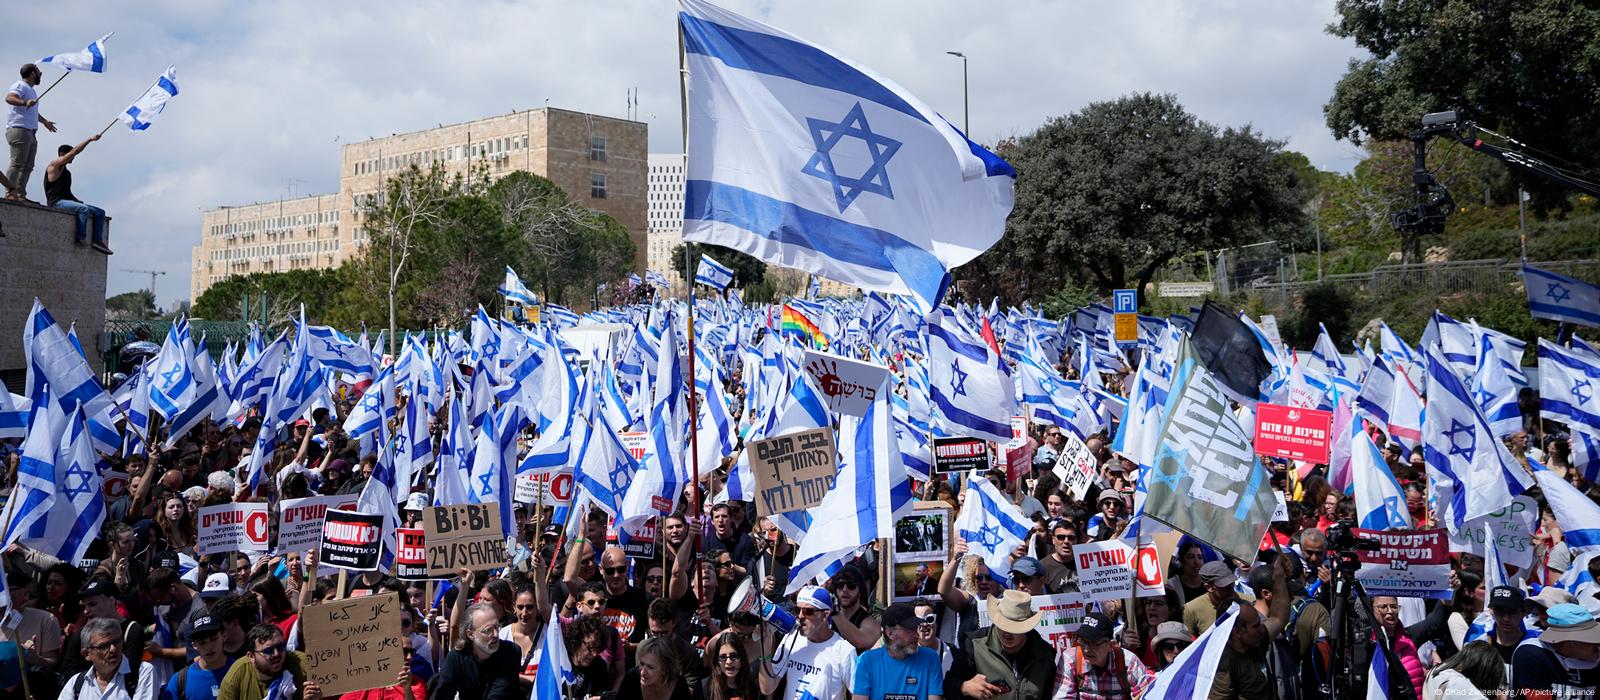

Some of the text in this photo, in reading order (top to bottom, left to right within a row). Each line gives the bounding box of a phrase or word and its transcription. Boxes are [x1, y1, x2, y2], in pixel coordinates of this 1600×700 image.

[1060, 453, 1075, 472] SIT
[202, 510, 244, 528] עוצרים
[1500, 521, 1521, 532] THE
[1458, 527, 1528, 552] ADESS
[1079, 548, 1126, 570] עוצרים
[1390, 559, 1408, 570] או
[329, 603, 357, 621] לא
[332, 622, 380, 641] מאמינה
[378, 637, 400, 652] שאני
[377, 657, 390, 671] על
[787, 659, 822, 675] וקרטיה
